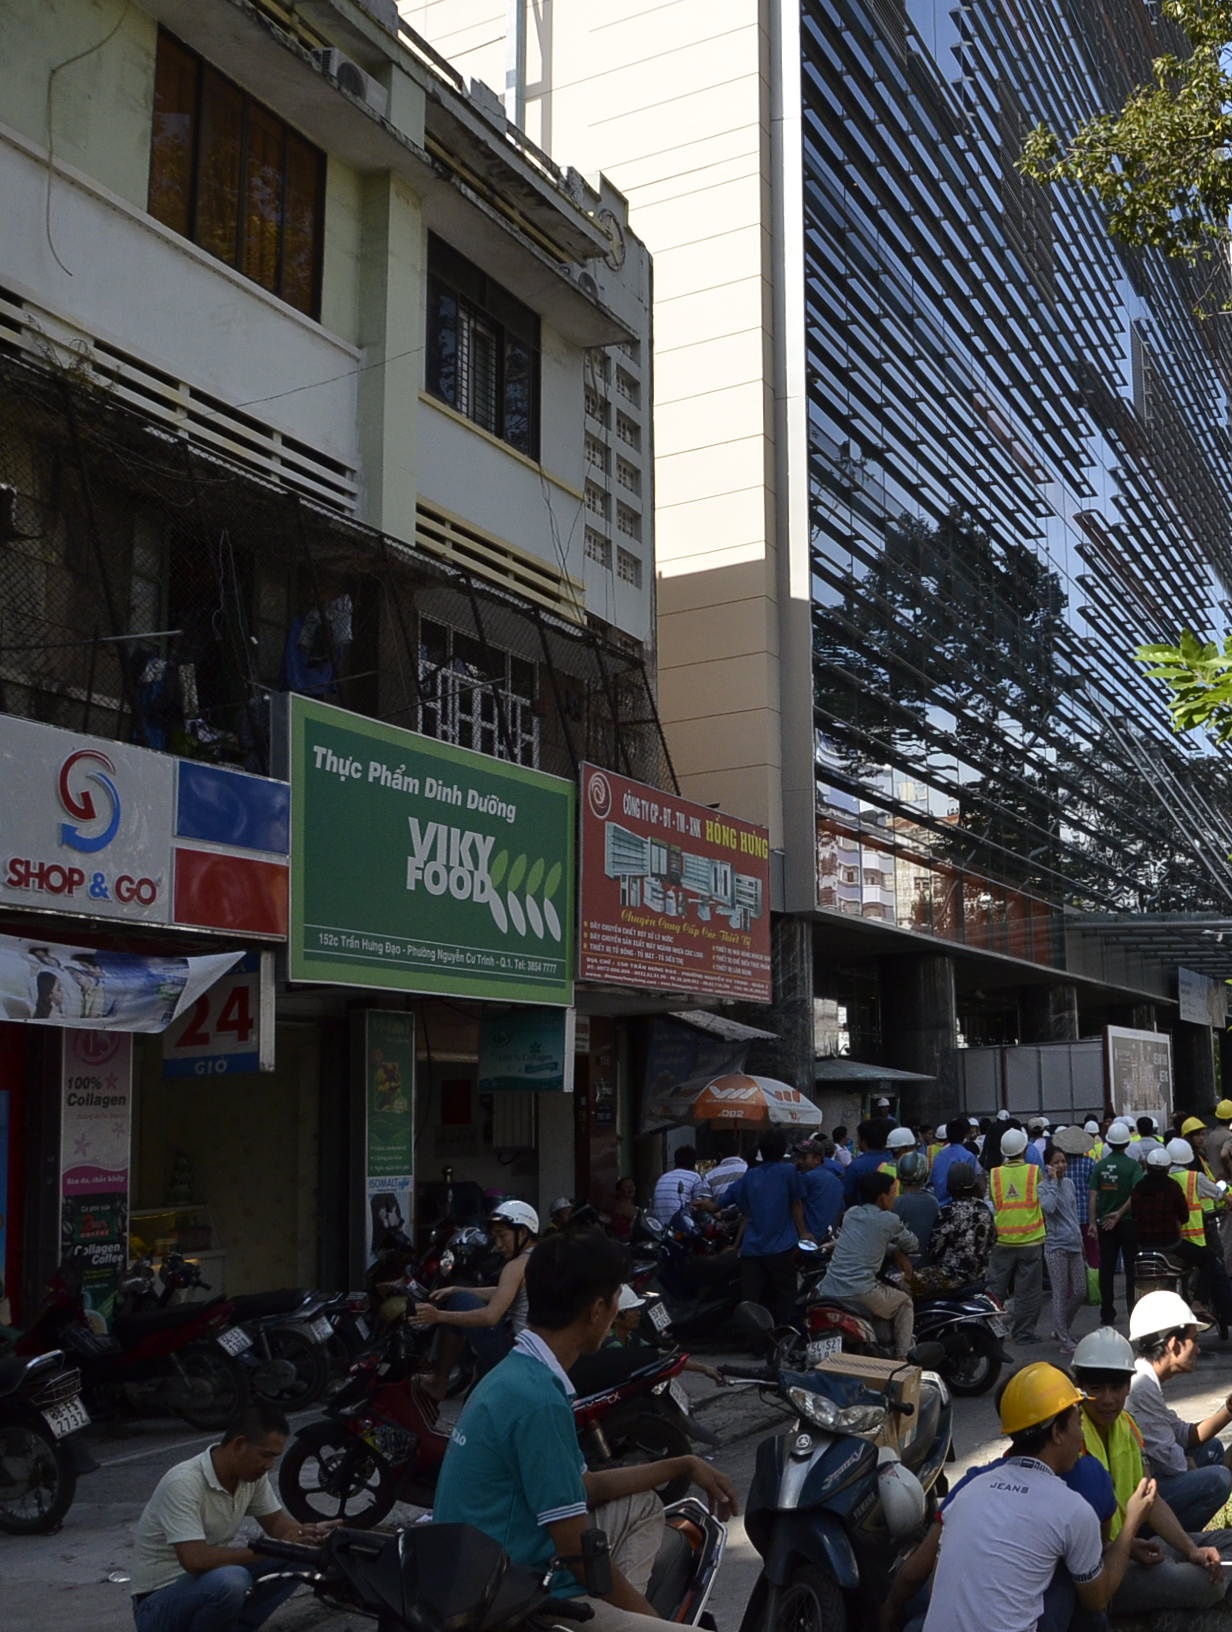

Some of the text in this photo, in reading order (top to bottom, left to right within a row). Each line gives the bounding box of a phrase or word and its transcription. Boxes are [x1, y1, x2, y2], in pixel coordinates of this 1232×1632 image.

[313, 745, 517, 823] Thực Phẩm Dinh Dưỡng
[641, 799, 649, 821] TY
[650, 803, 659, 823] CP
[408, 817, 495, 876] VIKY
[6, 857, 157, 905] SHOP & GO
[406, 856, 493, 903] FOOD
[319, 933, 338, 947] 152c
[175, 986, 254, 1048] 24
[67, 1075, 103, 1091] 100%
[67, 1093, 127, 1109] Collagen
[990, 1482, 1029, 1494] JEANS
